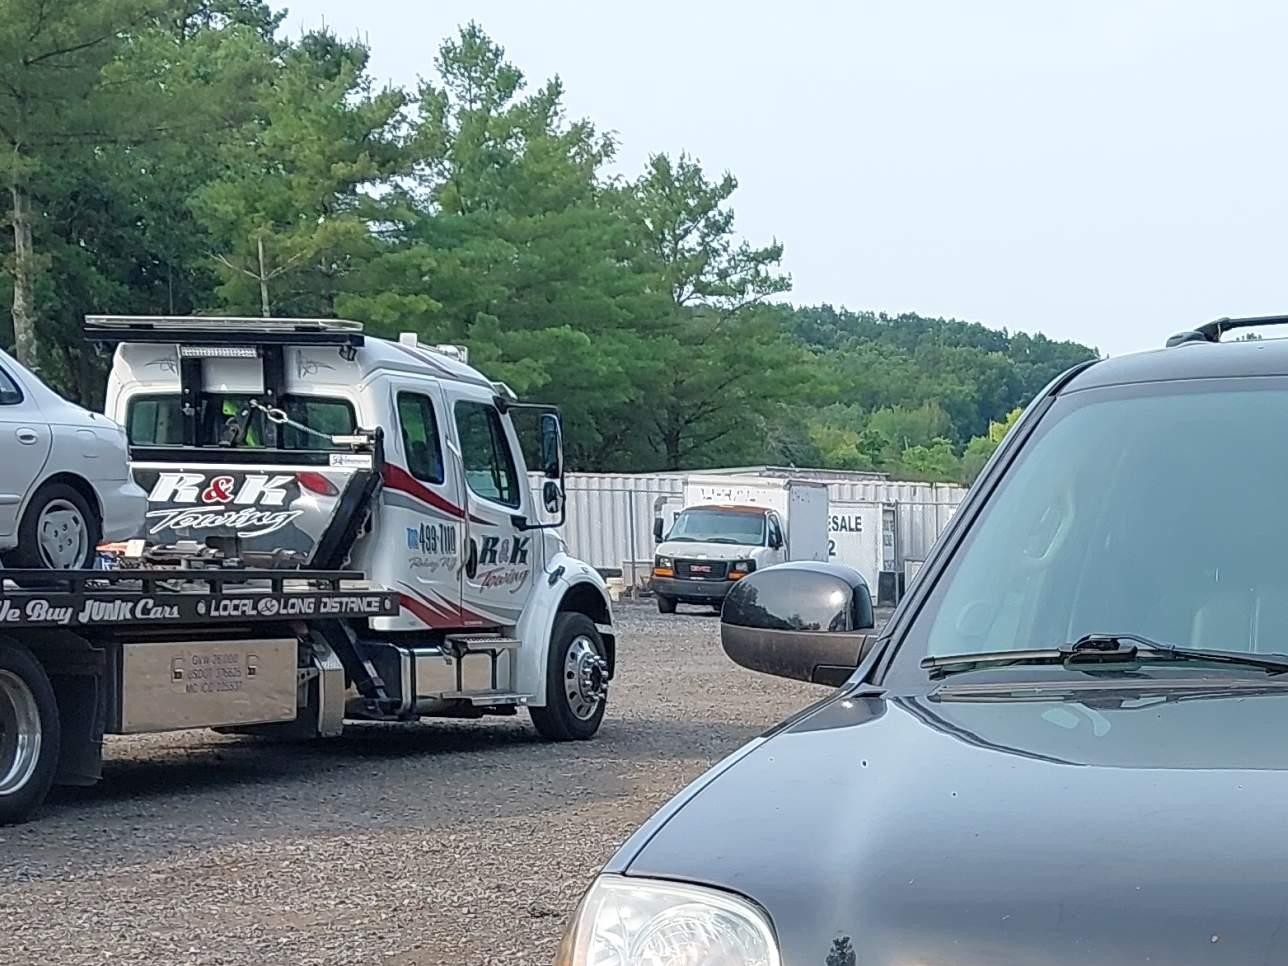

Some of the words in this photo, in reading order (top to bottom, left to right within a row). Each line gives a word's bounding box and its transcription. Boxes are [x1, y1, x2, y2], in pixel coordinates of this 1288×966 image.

[147, 472, 296, 506] R&K
[146, 506, 304, 538] Towing
[828, 515, 863, 532] SALE
[479, 534, 531, 566] R&K
[25, 599, 73, 625] Buy
[78, 599, 136, 624] JUNK
[135, 598, 181, 619] Cars
[210, 599, 258, 617] LOCAL
[279, 598, 316, 615] LONG
[320, 597, 381, 614] DISTANCE
